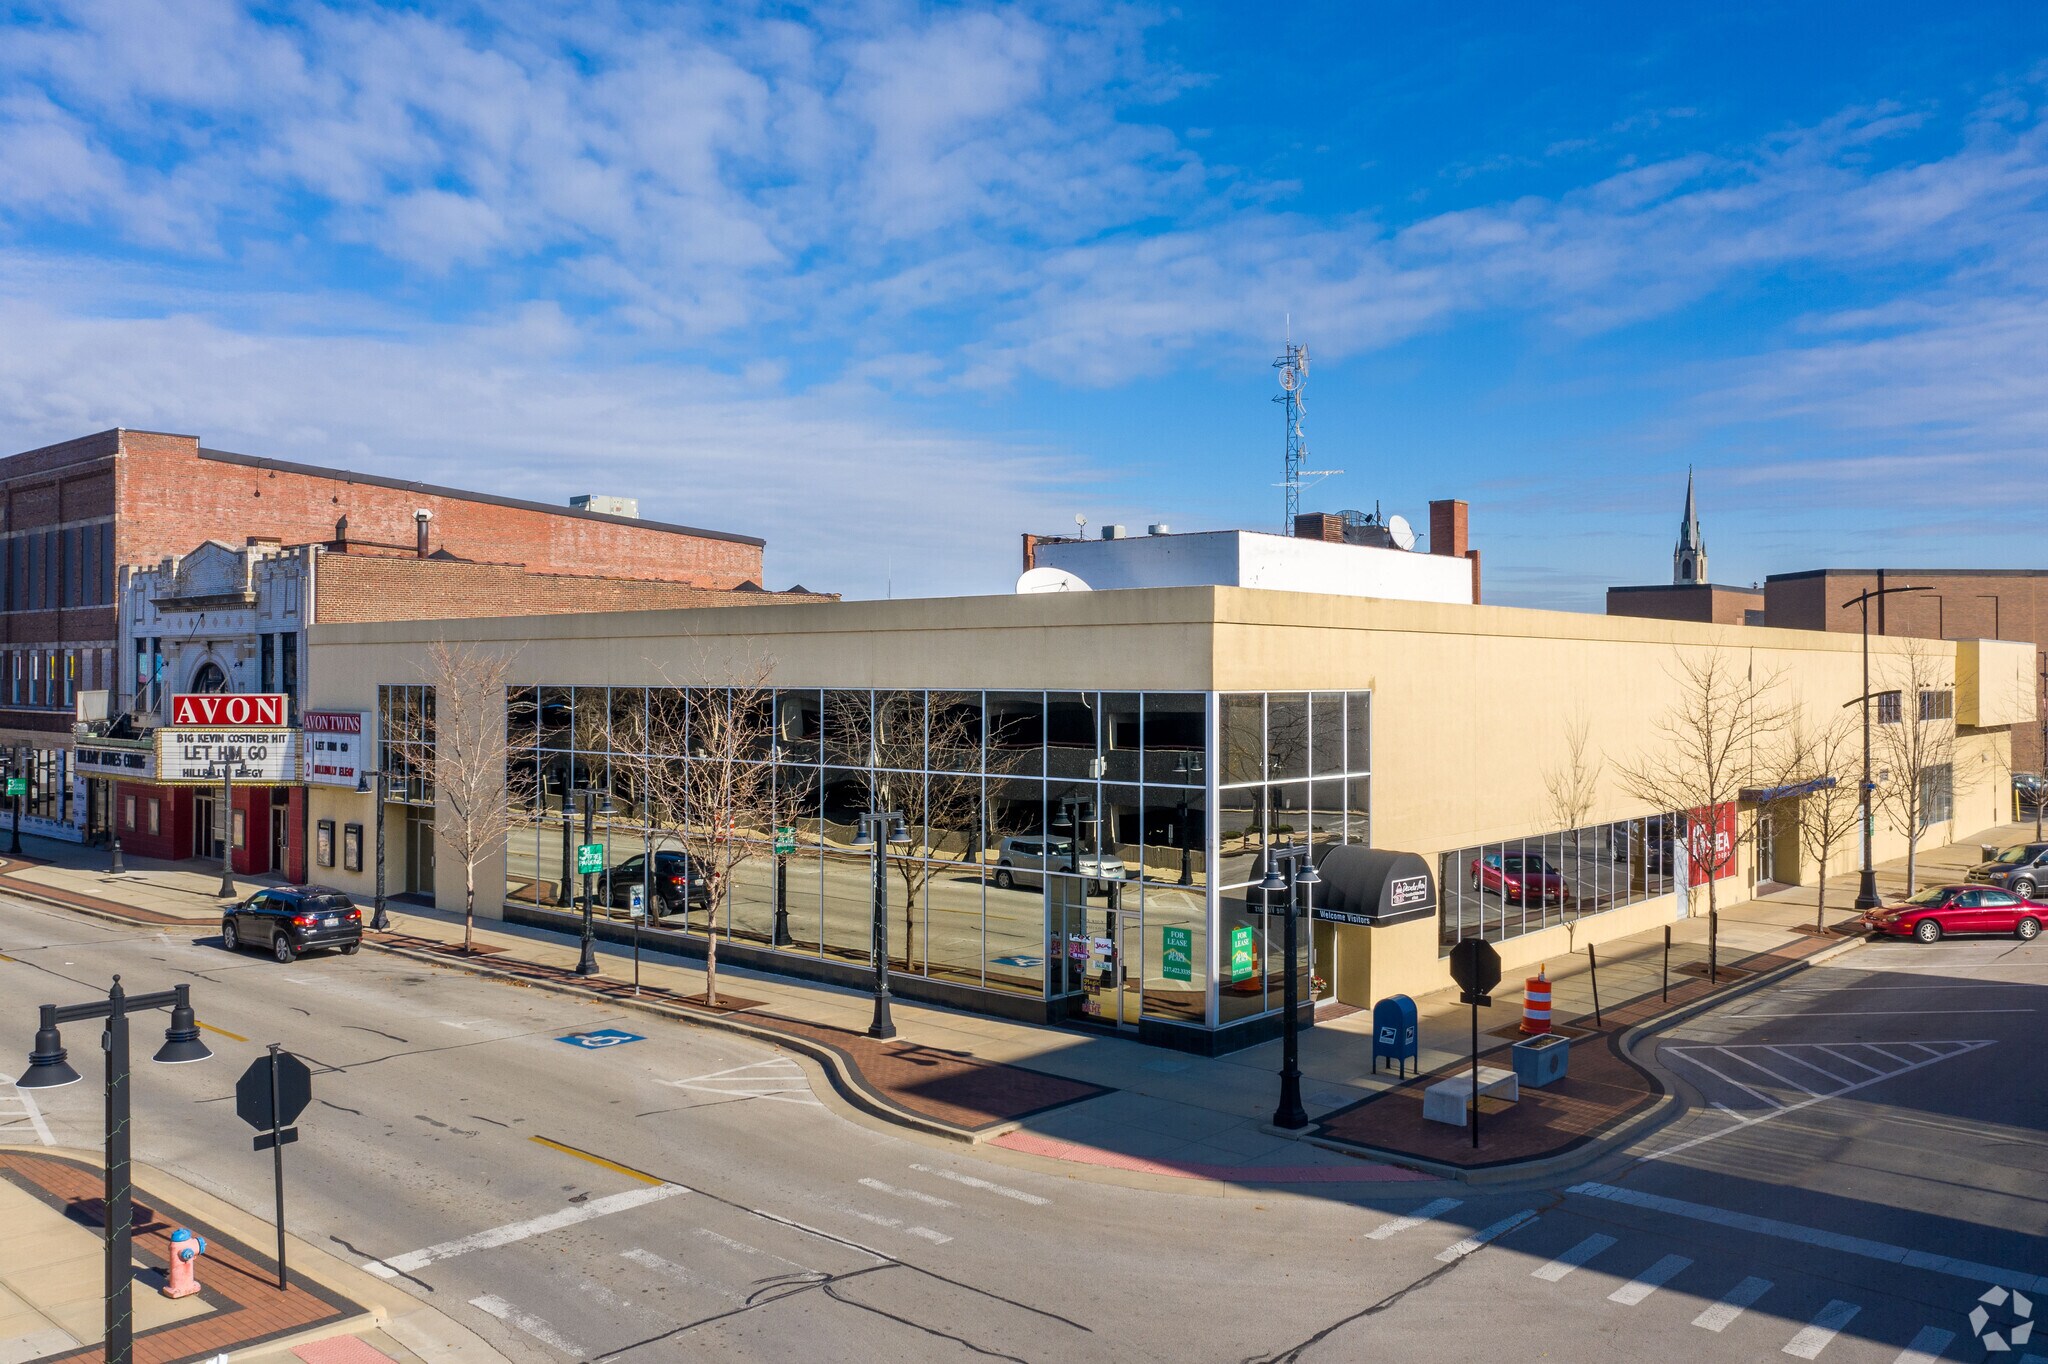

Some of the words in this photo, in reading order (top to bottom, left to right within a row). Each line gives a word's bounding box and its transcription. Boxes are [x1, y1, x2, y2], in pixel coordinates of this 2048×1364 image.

[176, 698, 278, 723] AVON
[305, 715, 328, 730] AVON
[330, 716, 360, 731] TWINS
[177, 734, 194, 743] BIG
[198, 734, 225, 743] KEVIN
[228, 734, 269, 743] COSTNER
[272, 734, 287, 743] HIT
[185, 745, 212, 760] LET
[218, 745, 242, 760] HIM
[248, 746, 267, 760] GO
[315, 741, 324, 750] LET
[341, 743, 348, 752] GO
[306, 762, 310, 776] 2
[1320, 910, 1346, 922] Welcome
[1347, 914, 1370, 924] Visitors
[1167, 938, 1188, 947] LEASE
[1235, 938, 1249, 948] LEASE
